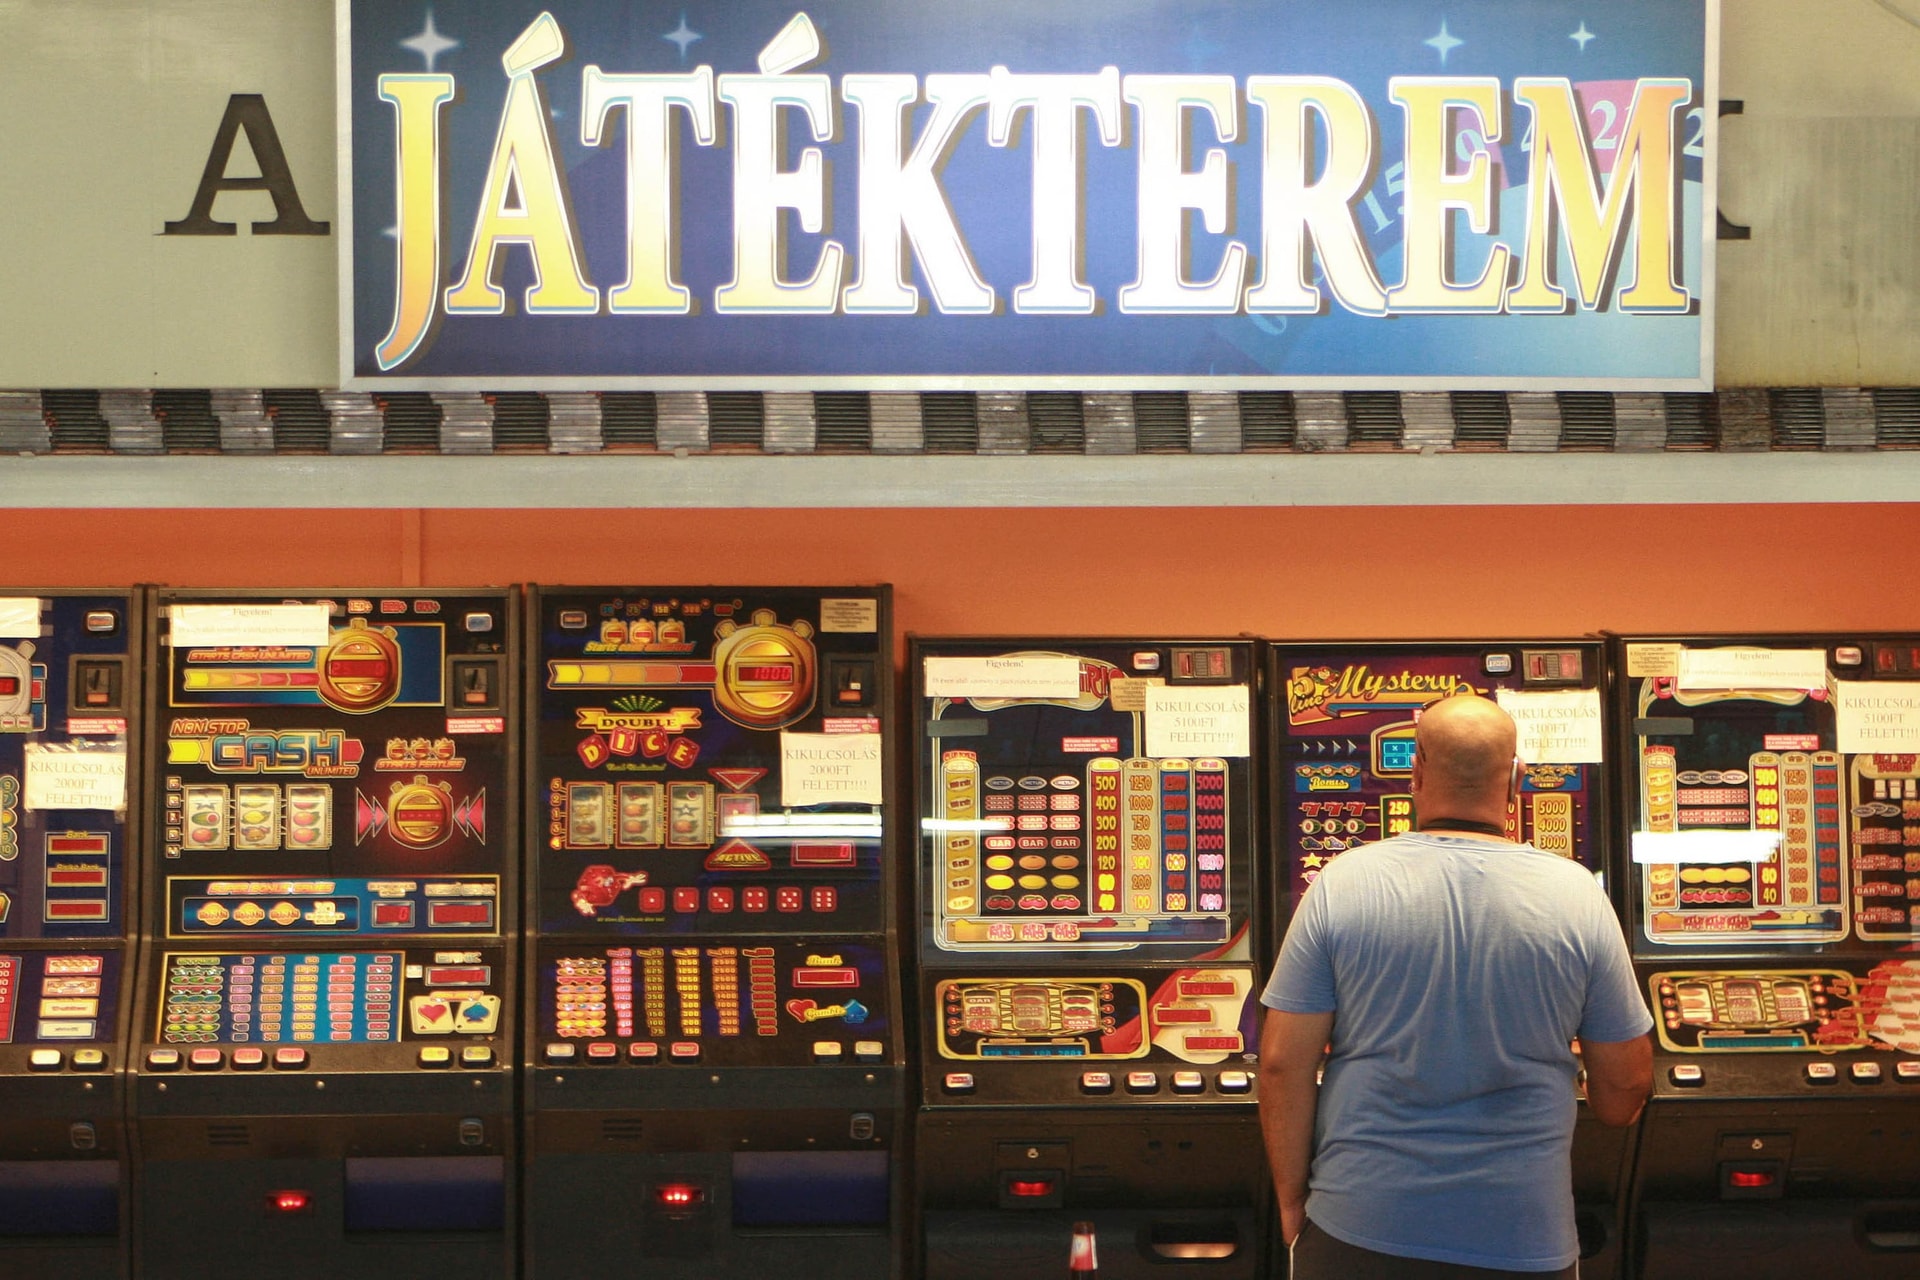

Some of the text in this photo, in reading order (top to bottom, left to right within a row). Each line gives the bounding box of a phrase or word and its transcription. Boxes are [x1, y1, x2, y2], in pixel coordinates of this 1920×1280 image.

[375, 10, 1696, 372] JÁTÉKTEREM
[233, 607, 273, 618] Figyelem!
[985, 659, 1024, 670] Figyelem!
[754, 666, 792, 680] 1000
[1324, 665, 1462, 700] Mystery
[1155, 699, 1246, 713] KIKULCSOLÁS
[1291, 694, 1324, 714] line
[1845, 697, 1920, 709] KIKULCSOL
[172, 720, 248, 734] NON STOP
[602, 718, 678, 727] DOUBLE
[1174, 716, 1216, 728] 5100FT
[213, 735, 339, 767] CASH
[785, 747, 878, 761] KIKULCSOLÁS
[30, 760, 124, 776] KIKULCSOLÁS
[306, 767, 358, 776] UNLIMITED
[809, 764, 851, 776] 2000FT
[1095, 776, 1223, 790] 500 1250 5000
[1095, 796, 1224, 810] 400 1000 4000
[1388, 801, 1410, 815] 250
[1539, 801, 1566, 814] 5000
[1096, 815, 1224, 830] 300 750 3000
[1389, 818, 1410, 832] 200
[1539, 819, 1567, 832] 4000
[990, 839, 1077, 847] BAR BAR BAR
[1096, 835, 1224, 850] 200 500 2000
[1540, 835, 1567, 849] 3000
[716, 853, 762, 863] ACTIVE
[1097, 855, 1116, 870] 120
[1131, 874, 1152, 890] 200
[1132, 894, 1152, 910] 100
[1763, 888, 1777, 903] 40
